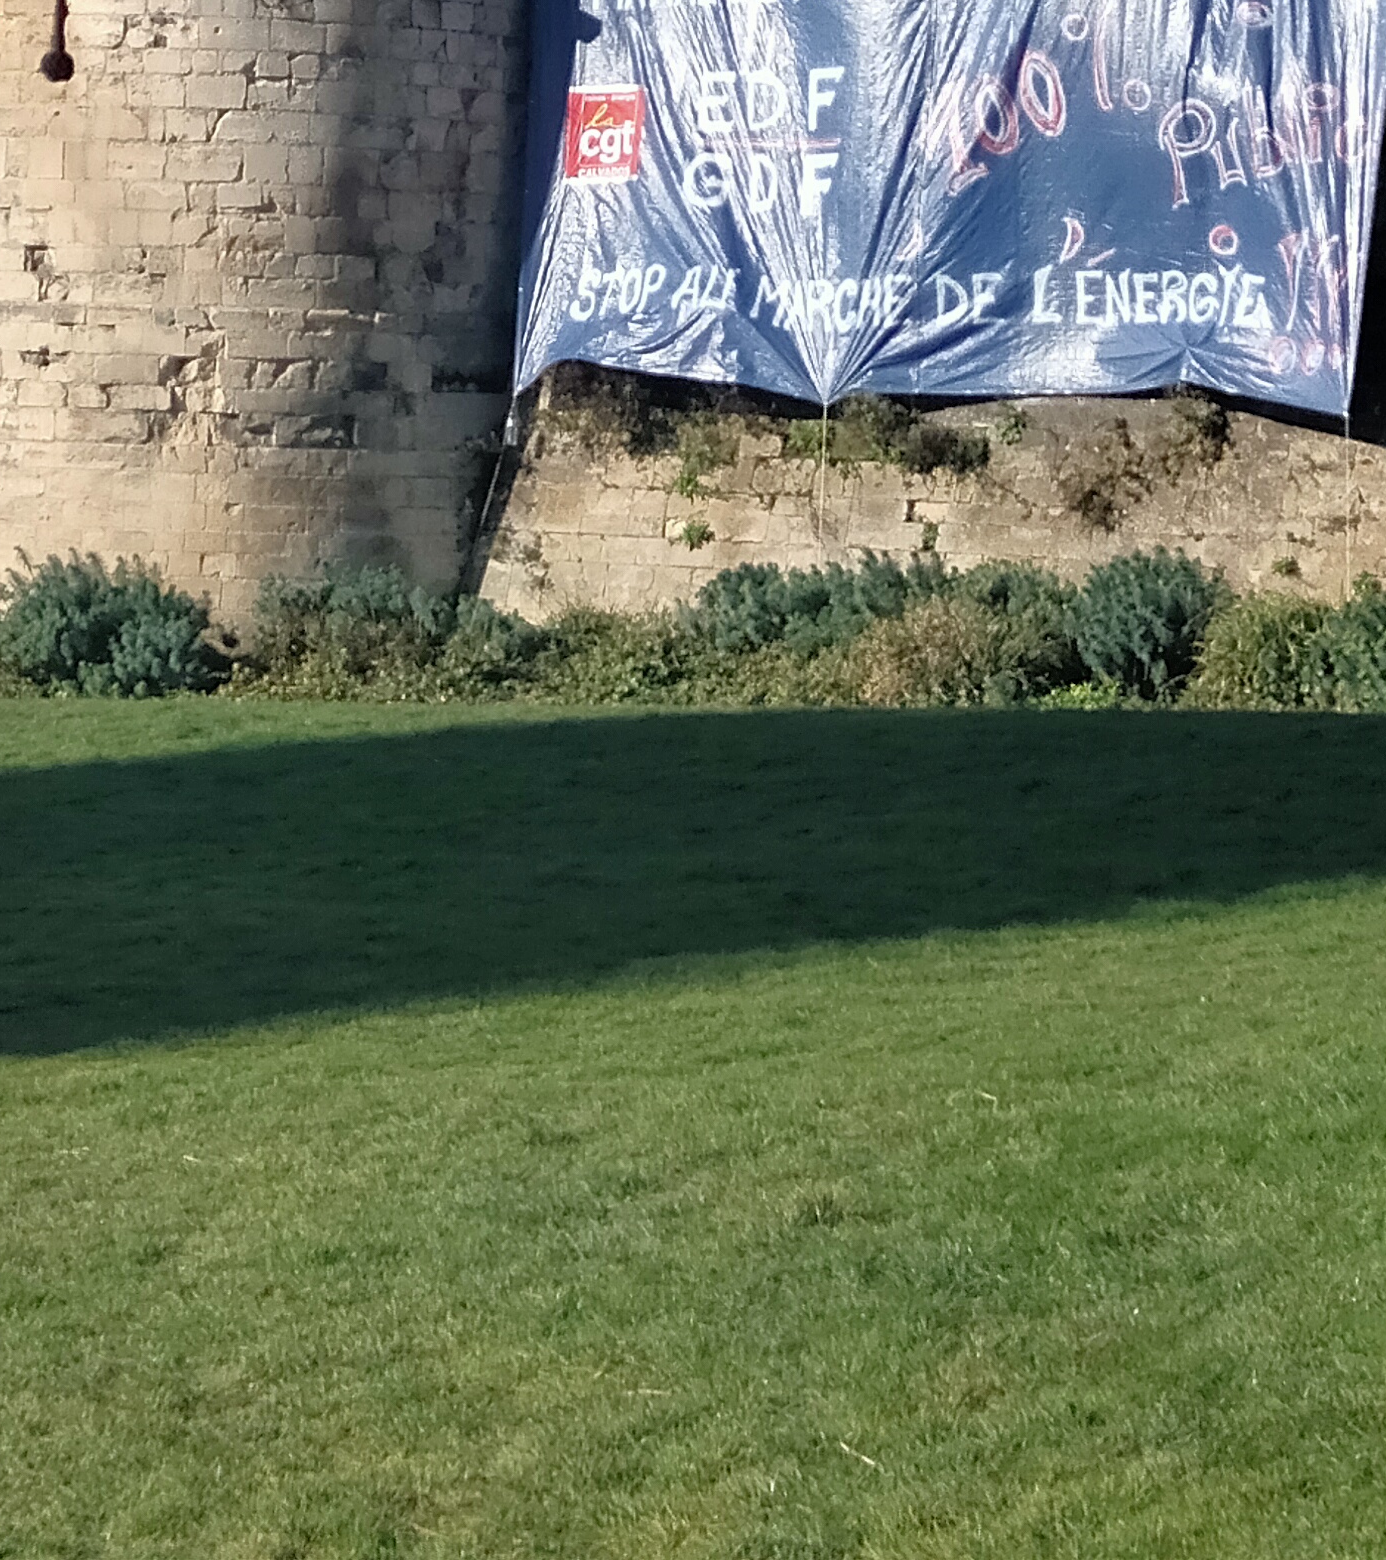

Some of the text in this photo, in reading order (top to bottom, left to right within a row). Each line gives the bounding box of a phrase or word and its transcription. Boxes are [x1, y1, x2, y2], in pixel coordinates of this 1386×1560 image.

[699, 65, 845, 134] EDF
[579, 120, 636, 164] cgt
[684, 151, 839, 217] GDF
[569, 263, 667, 321] STOP
[672, 265, 737, 309] AU
[935, 271, 1004, 326] DE
